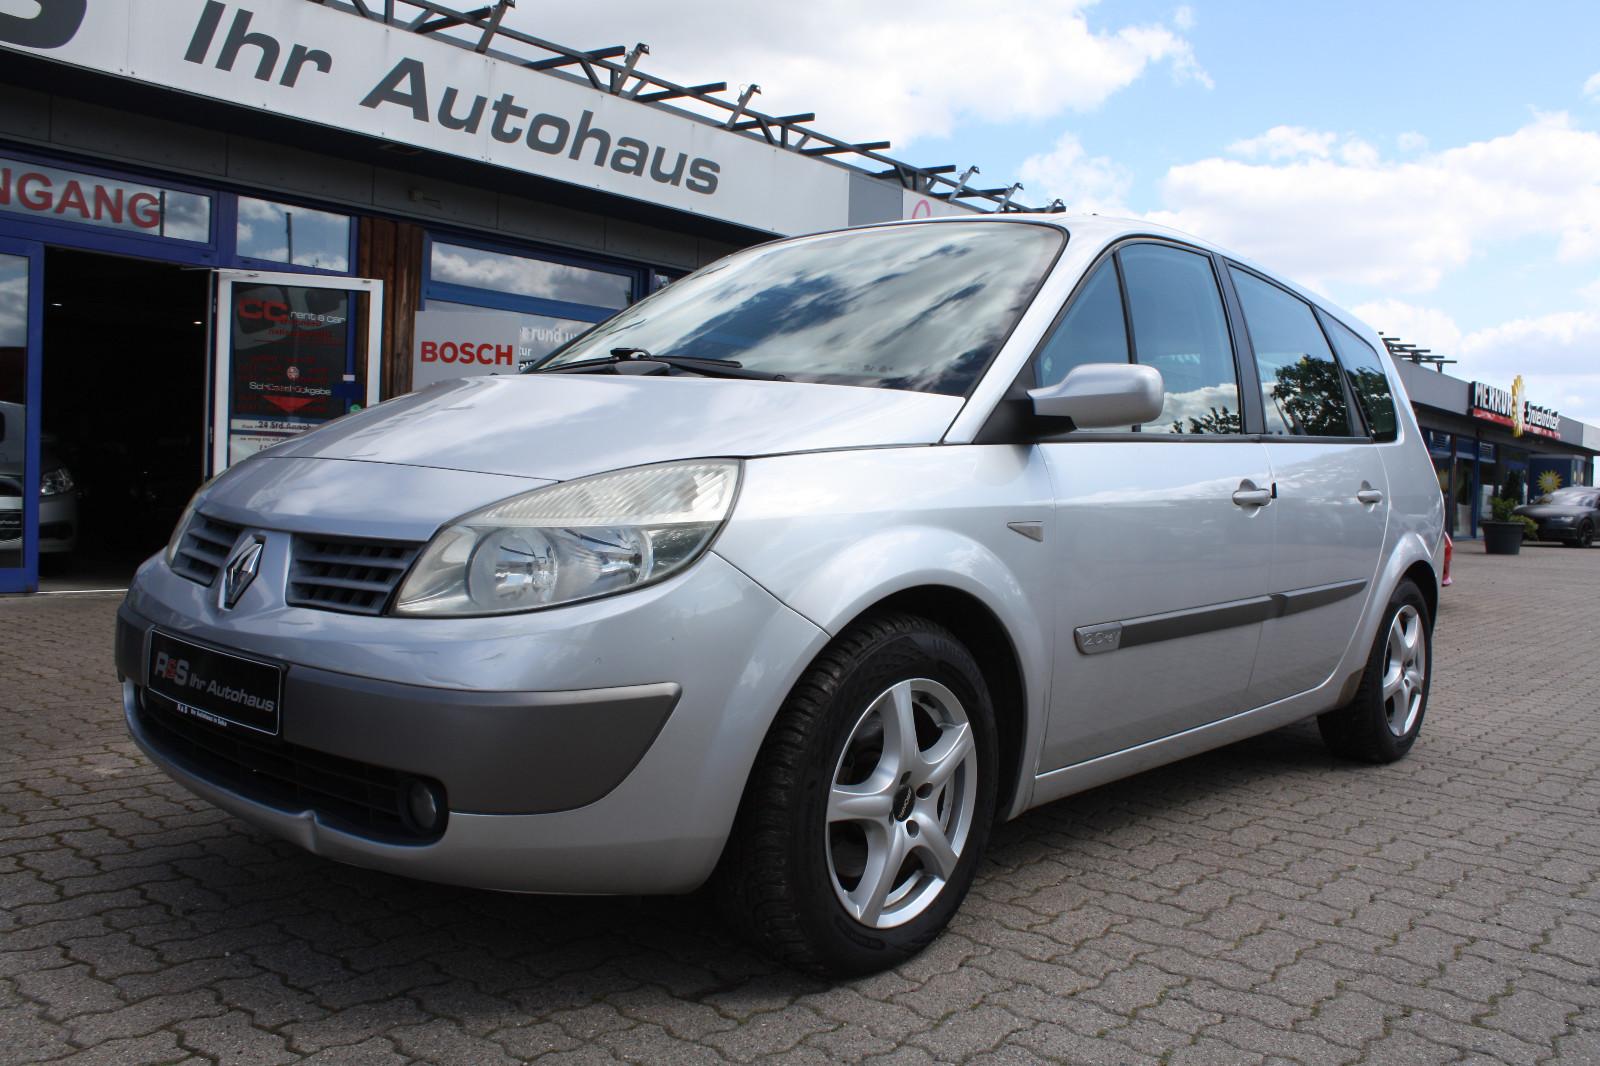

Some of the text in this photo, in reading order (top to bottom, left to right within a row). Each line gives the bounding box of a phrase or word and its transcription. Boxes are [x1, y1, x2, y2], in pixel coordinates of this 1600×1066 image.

[184, 0, 333, 89] Ihr
[360, 56, 721, 196] Autohaus
[420, 341, 513, 366] BOSCH
[1474, 381, 1513, 417] MERKUR
[188, 672, 207, 691] Ihr
[206, 679, 275, 713] Autohaus
